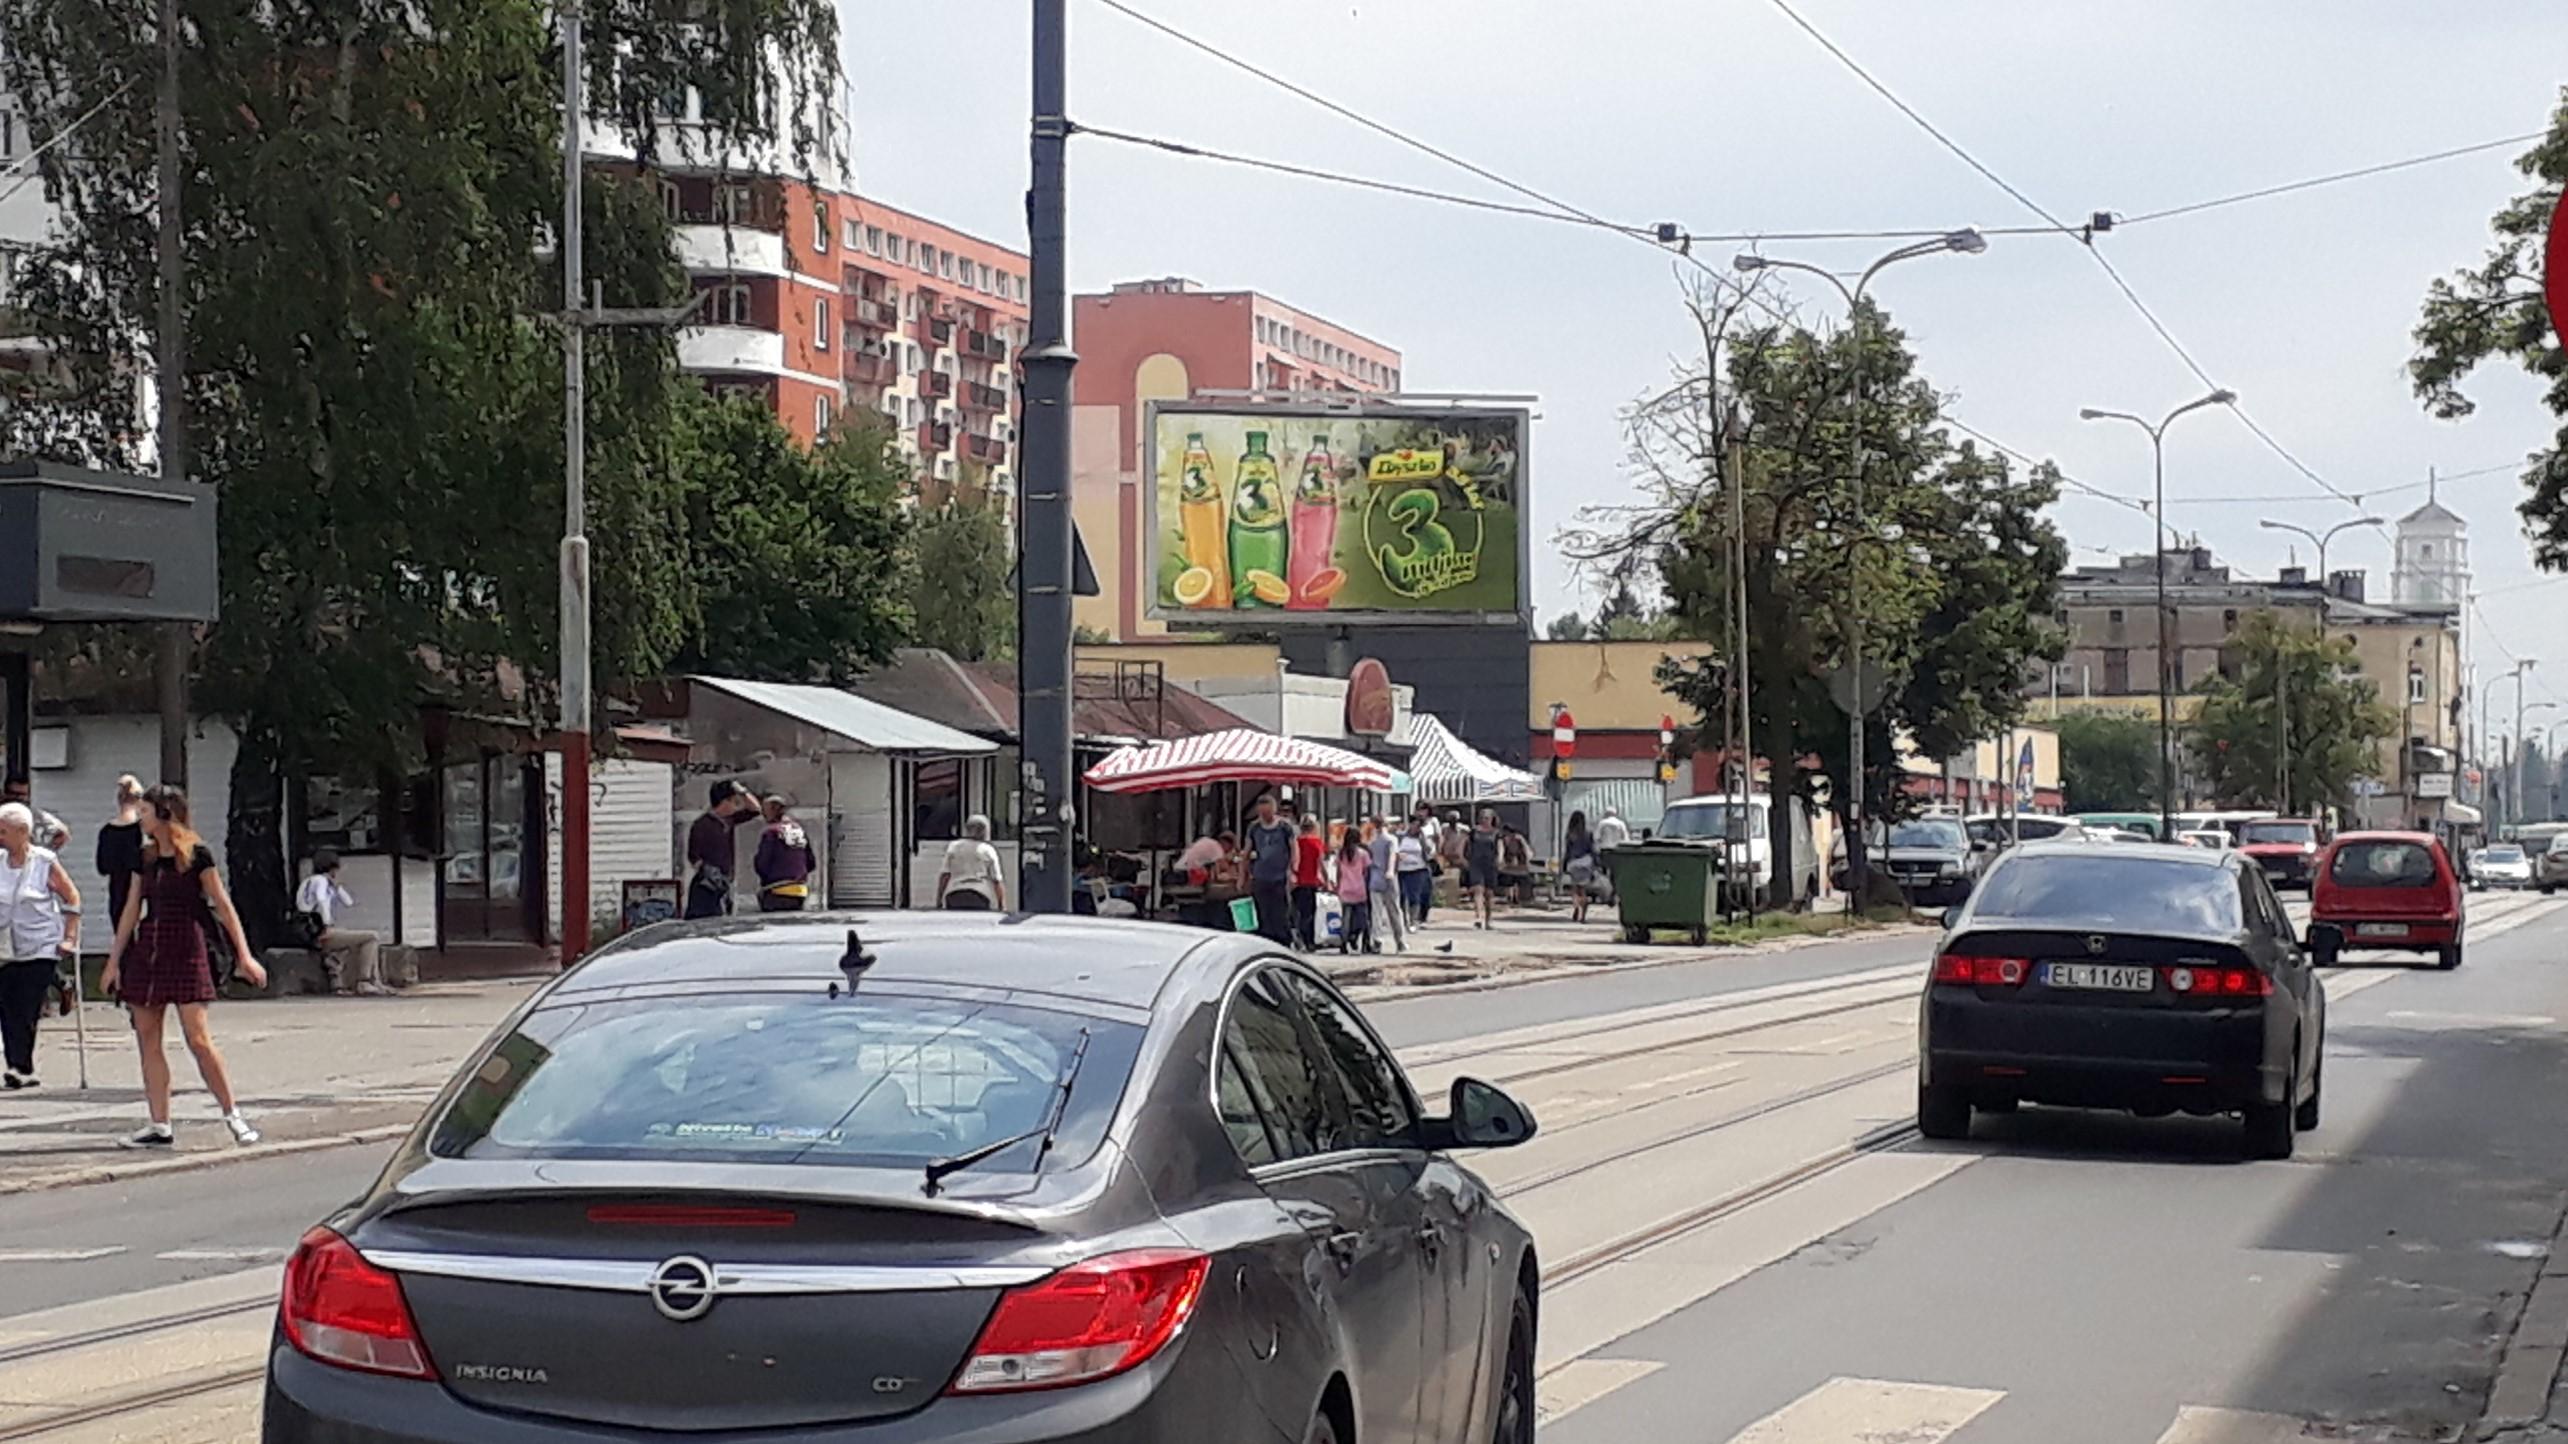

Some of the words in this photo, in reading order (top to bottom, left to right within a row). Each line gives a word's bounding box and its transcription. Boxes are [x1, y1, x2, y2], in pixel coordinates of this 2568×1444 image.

[1236, 478, 1269, 523] 3
[1379, 488, 1455, 597] 3
[2088, 967, 2149, 989] 116VE
[456, 1364, 548, 1382] INSIGNIA
